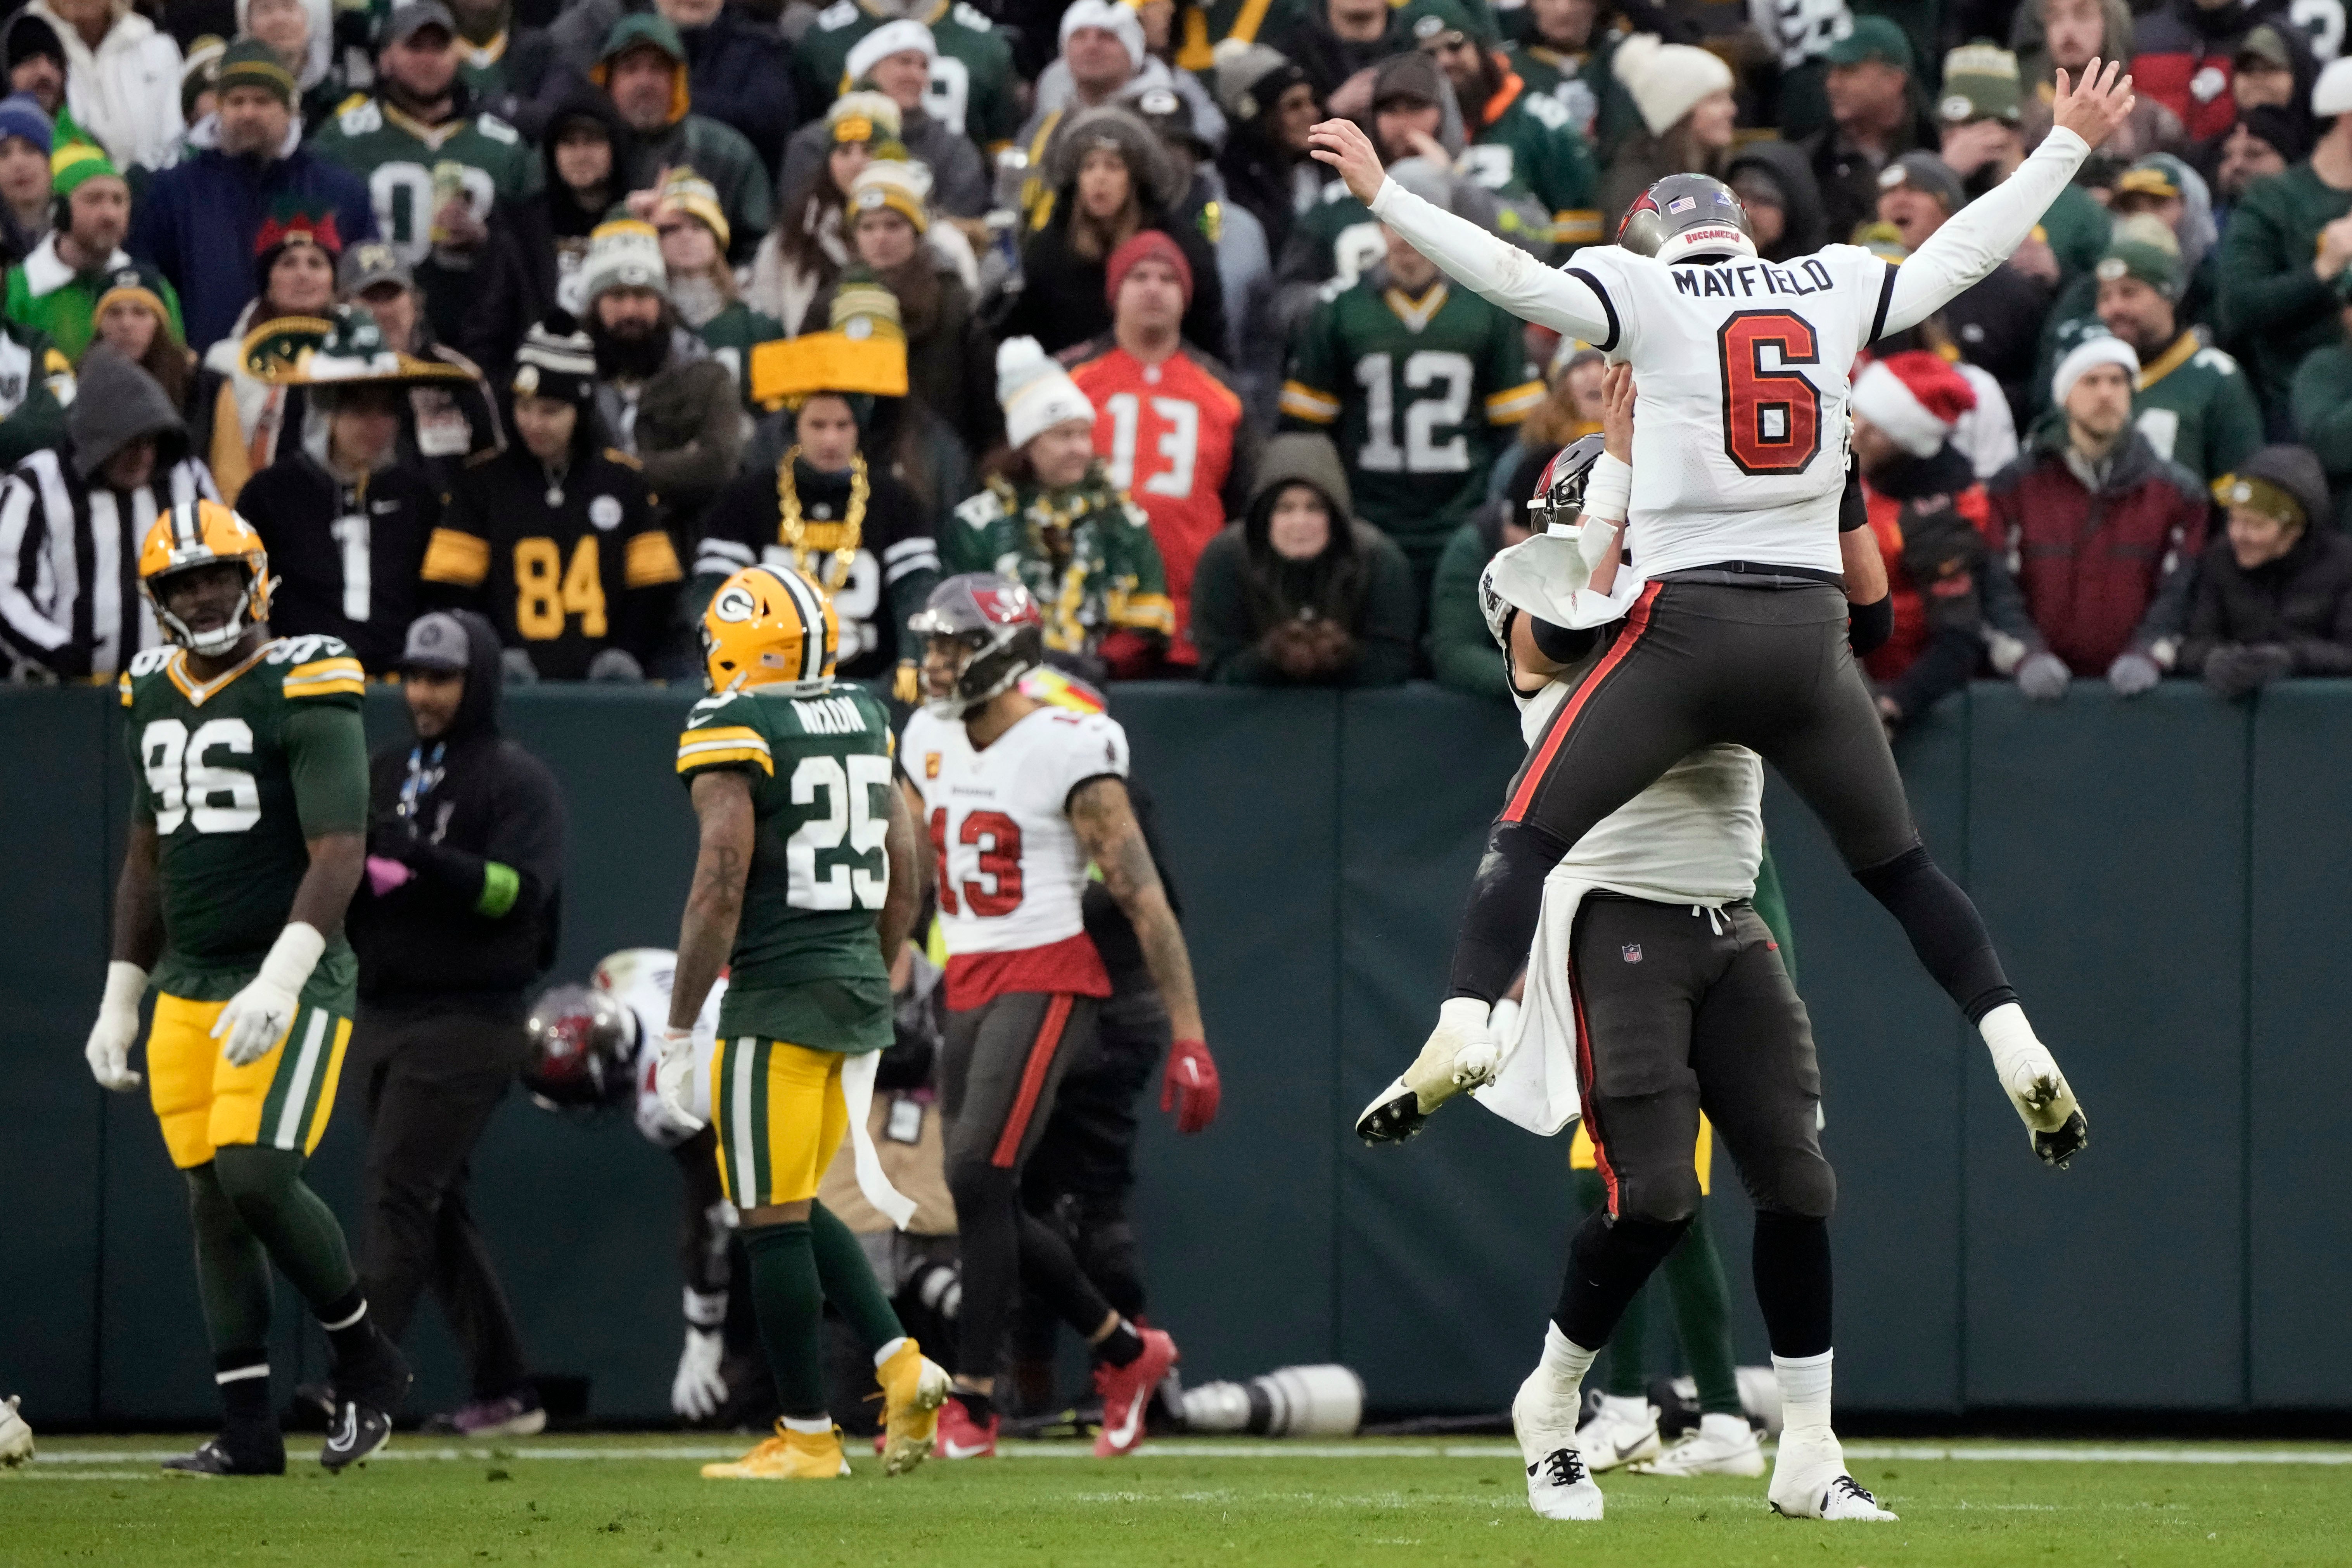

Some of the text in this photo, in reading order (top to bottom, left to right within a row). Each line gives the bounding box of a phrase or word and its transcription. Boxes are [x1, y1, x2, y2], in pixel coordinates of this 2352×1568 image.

[1671, 259, 1833, 297] MAYFIELD
[1685, 230, 1740, 244] BUCCANEERS
[1107, 393, 1198, 498] 13
[1355, 350, 1474, 473] 12
[1717, 309, 1821, 475] 6
[331, 515, 371, 622] 1
[513, 534, 608, 641] 84
[715, 587, 754, 623] G
[790, 696, 867, 734] NIXON
[141, 718, 262, 835] 96
[786, 754, 892, 911] 25
[930, 807, 1023, 917] 13
